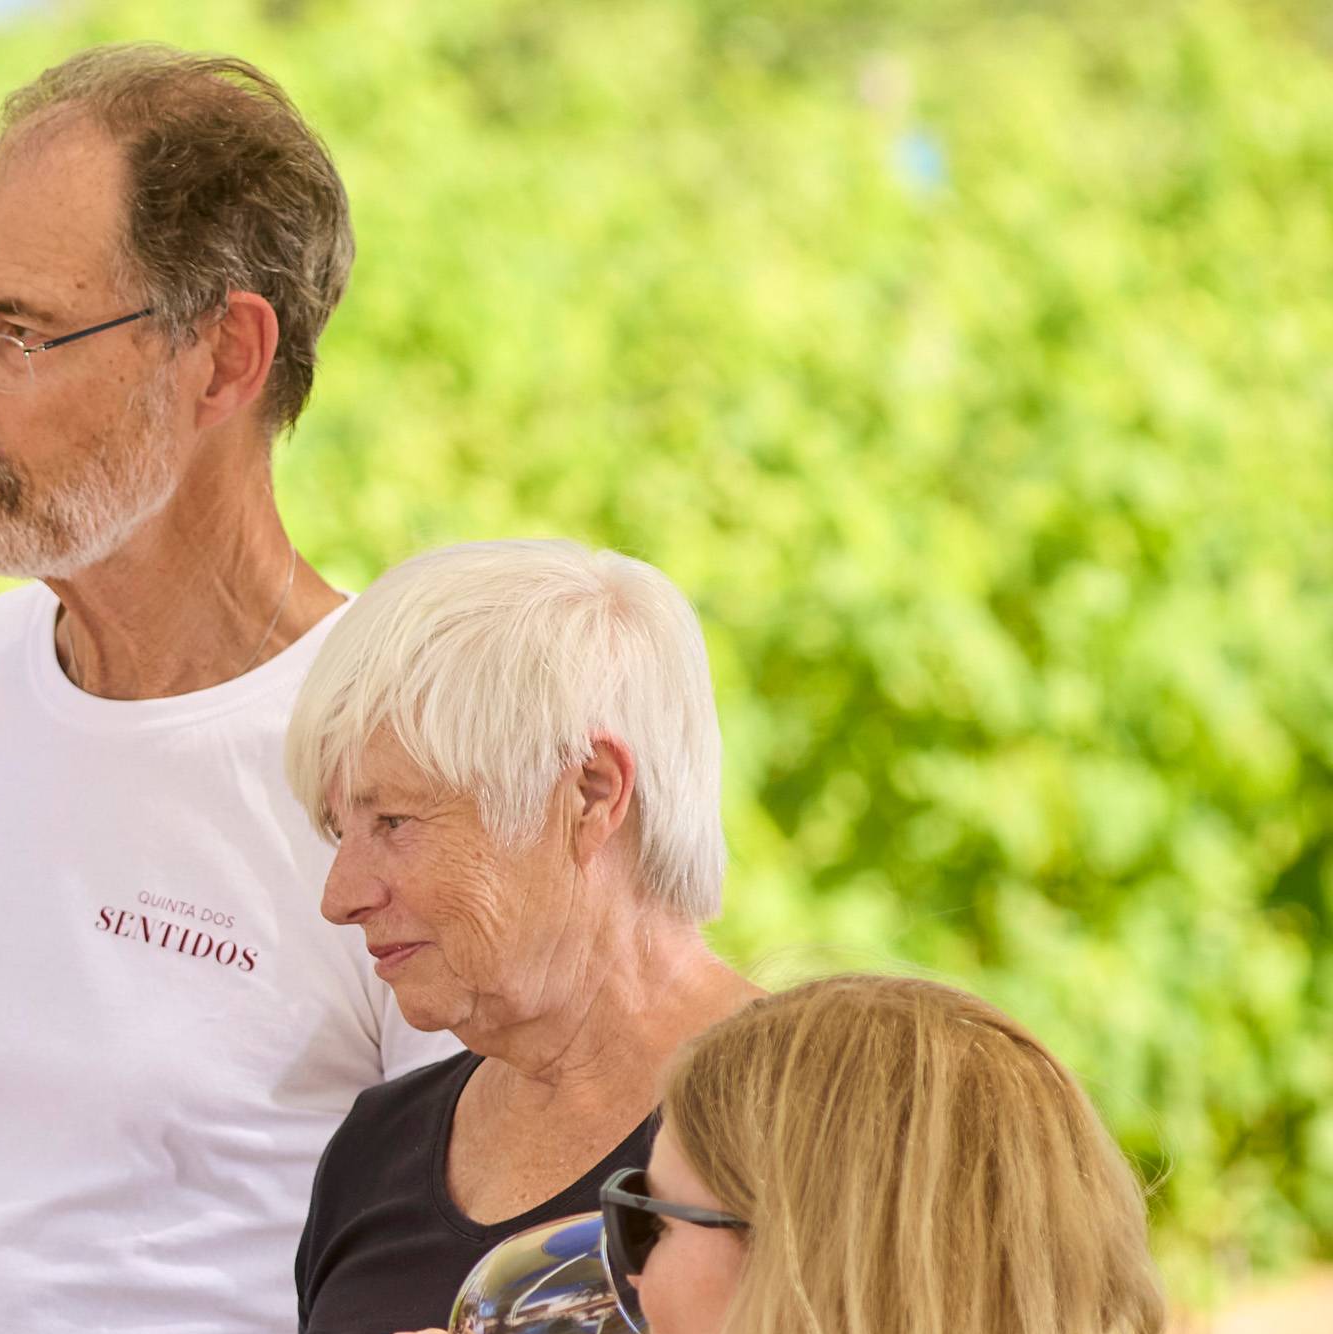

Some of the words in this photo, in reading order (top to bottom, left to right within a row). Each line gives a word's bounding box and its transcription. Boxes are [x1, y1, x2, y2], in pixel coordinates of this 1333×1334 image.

[137, 890, 196, 918] QUINTA
[200, 907, 236, 929] DOS
[95, 905, 258, 972] SENTIDOS
